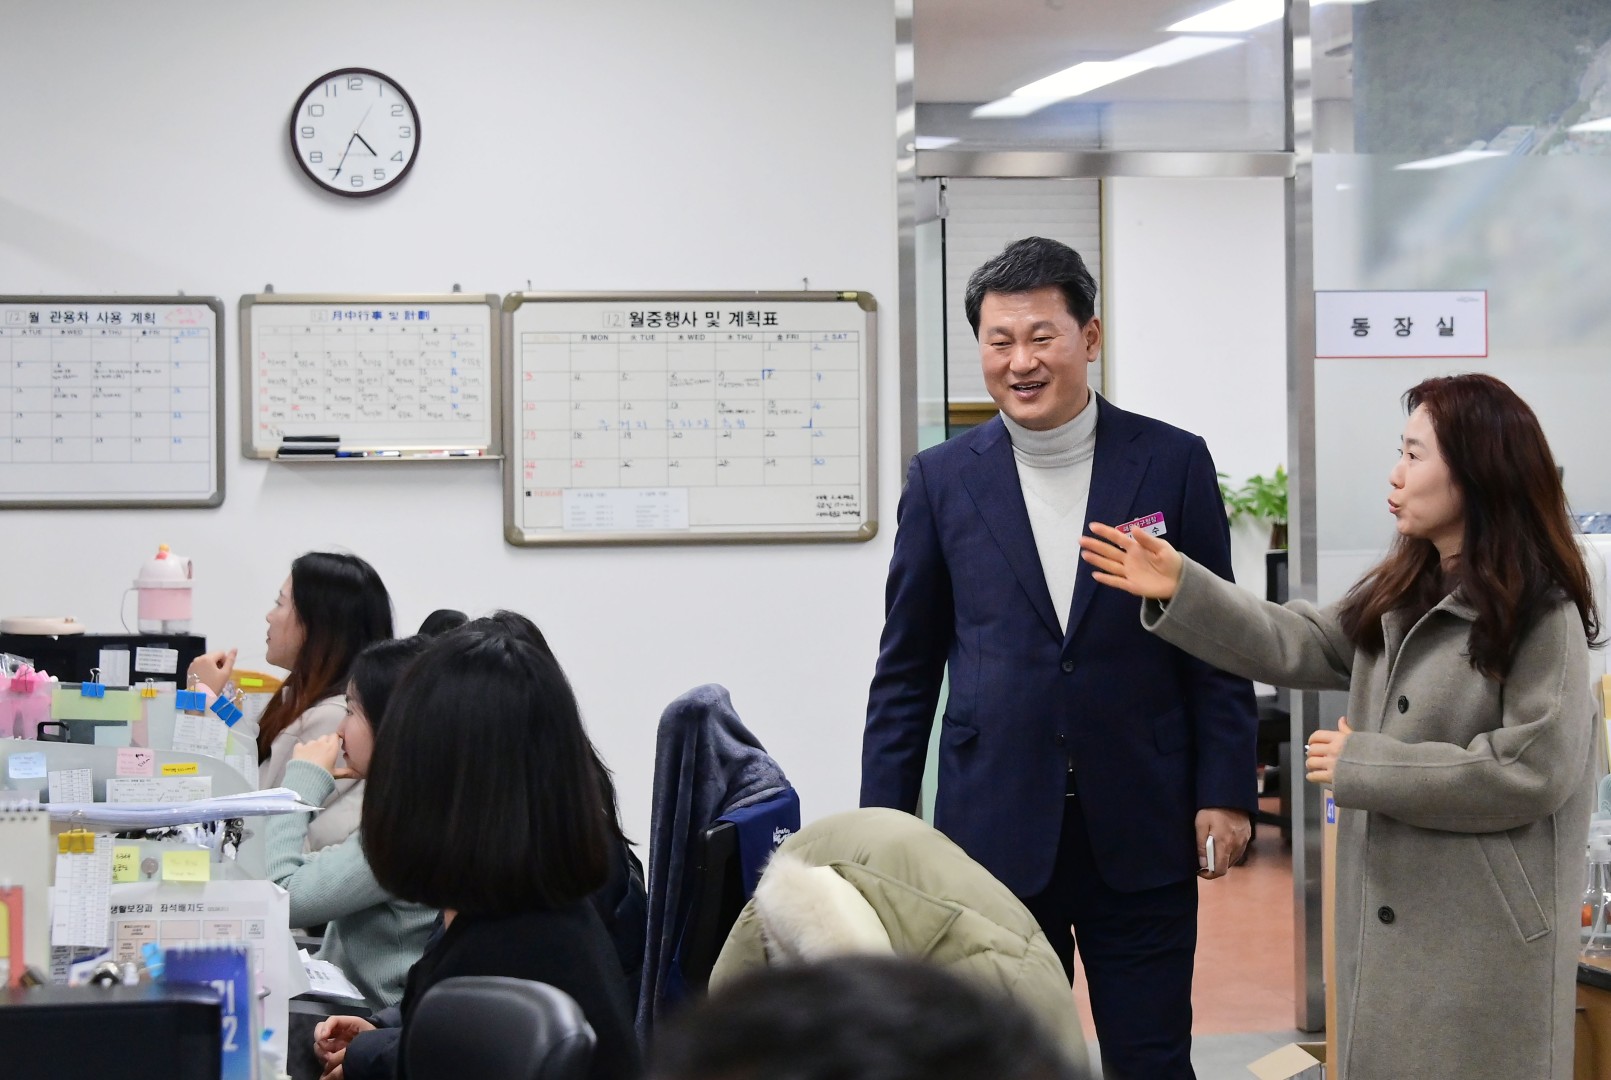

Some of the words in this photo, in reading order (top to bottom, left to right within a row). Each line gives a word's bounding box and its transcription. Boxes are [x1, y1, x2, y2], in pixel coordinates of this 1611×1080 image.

[347, 77, 363, 90] 12
[325, 84, 336, 97] 11
[379, 83, 383, 97] 1
[307, 104, 324, 117] 10
[391, 104, 404, 117] 2
[301, 126, 314, 138] 9
[399, 126, 411, 138] 3
[310, 151, 323, 163] 8
[390, 151, 403, 161] 4
[328, 168, 341, 180] 7
[374, 168, 385, 180] 5
[351, 176, 363, 187] 6
[29, 311, 39, 323] 월
[50, 310, 89, 324] 관용차
[96, 311, 122, 325] 사용
[131, 312, 156, 324] 계획
[332, 310, 383, 321] 月中行事
[629, 311, 698, 328] 월중행사
[705, 311, 720, 328] 및
[729, 311, 779, 328] 계획표
[1351, 317, 1371, 337] 동
[1393, 317, 1413, 337] 장
[110, 903, 153, 915] 생활보장과
